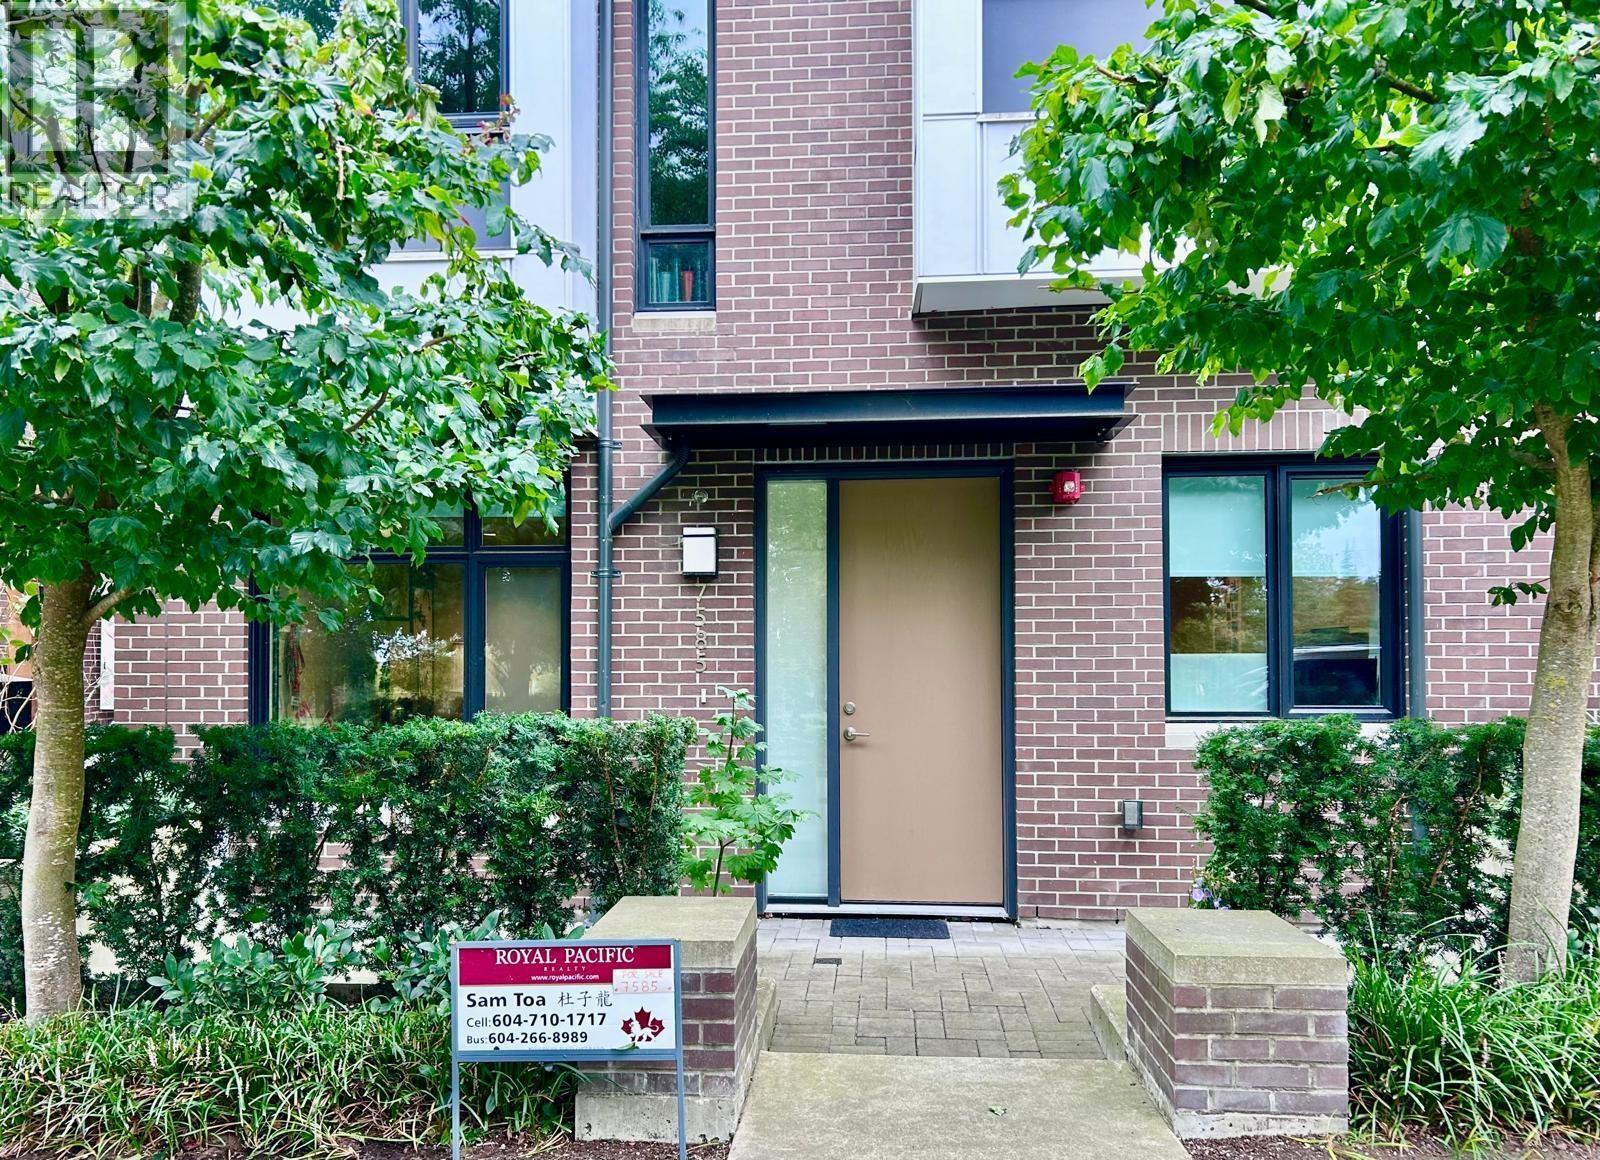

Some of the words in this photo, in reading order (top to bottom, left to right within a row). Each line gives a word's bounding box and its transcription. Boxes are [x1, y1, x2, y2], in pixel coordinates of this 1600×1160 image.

[495, 949, 557, 965] ROYAL
[564, 947, 635, 963] PACIFIC
[531, 973, 600, 981] www.royalpacific.com
[620, 980, 659, 992] 7585
[466, 993, 507, 1008] Sam
[513, 992, 546, 1007] Toa
[557, 990, 613, 1008] 杜子龍
